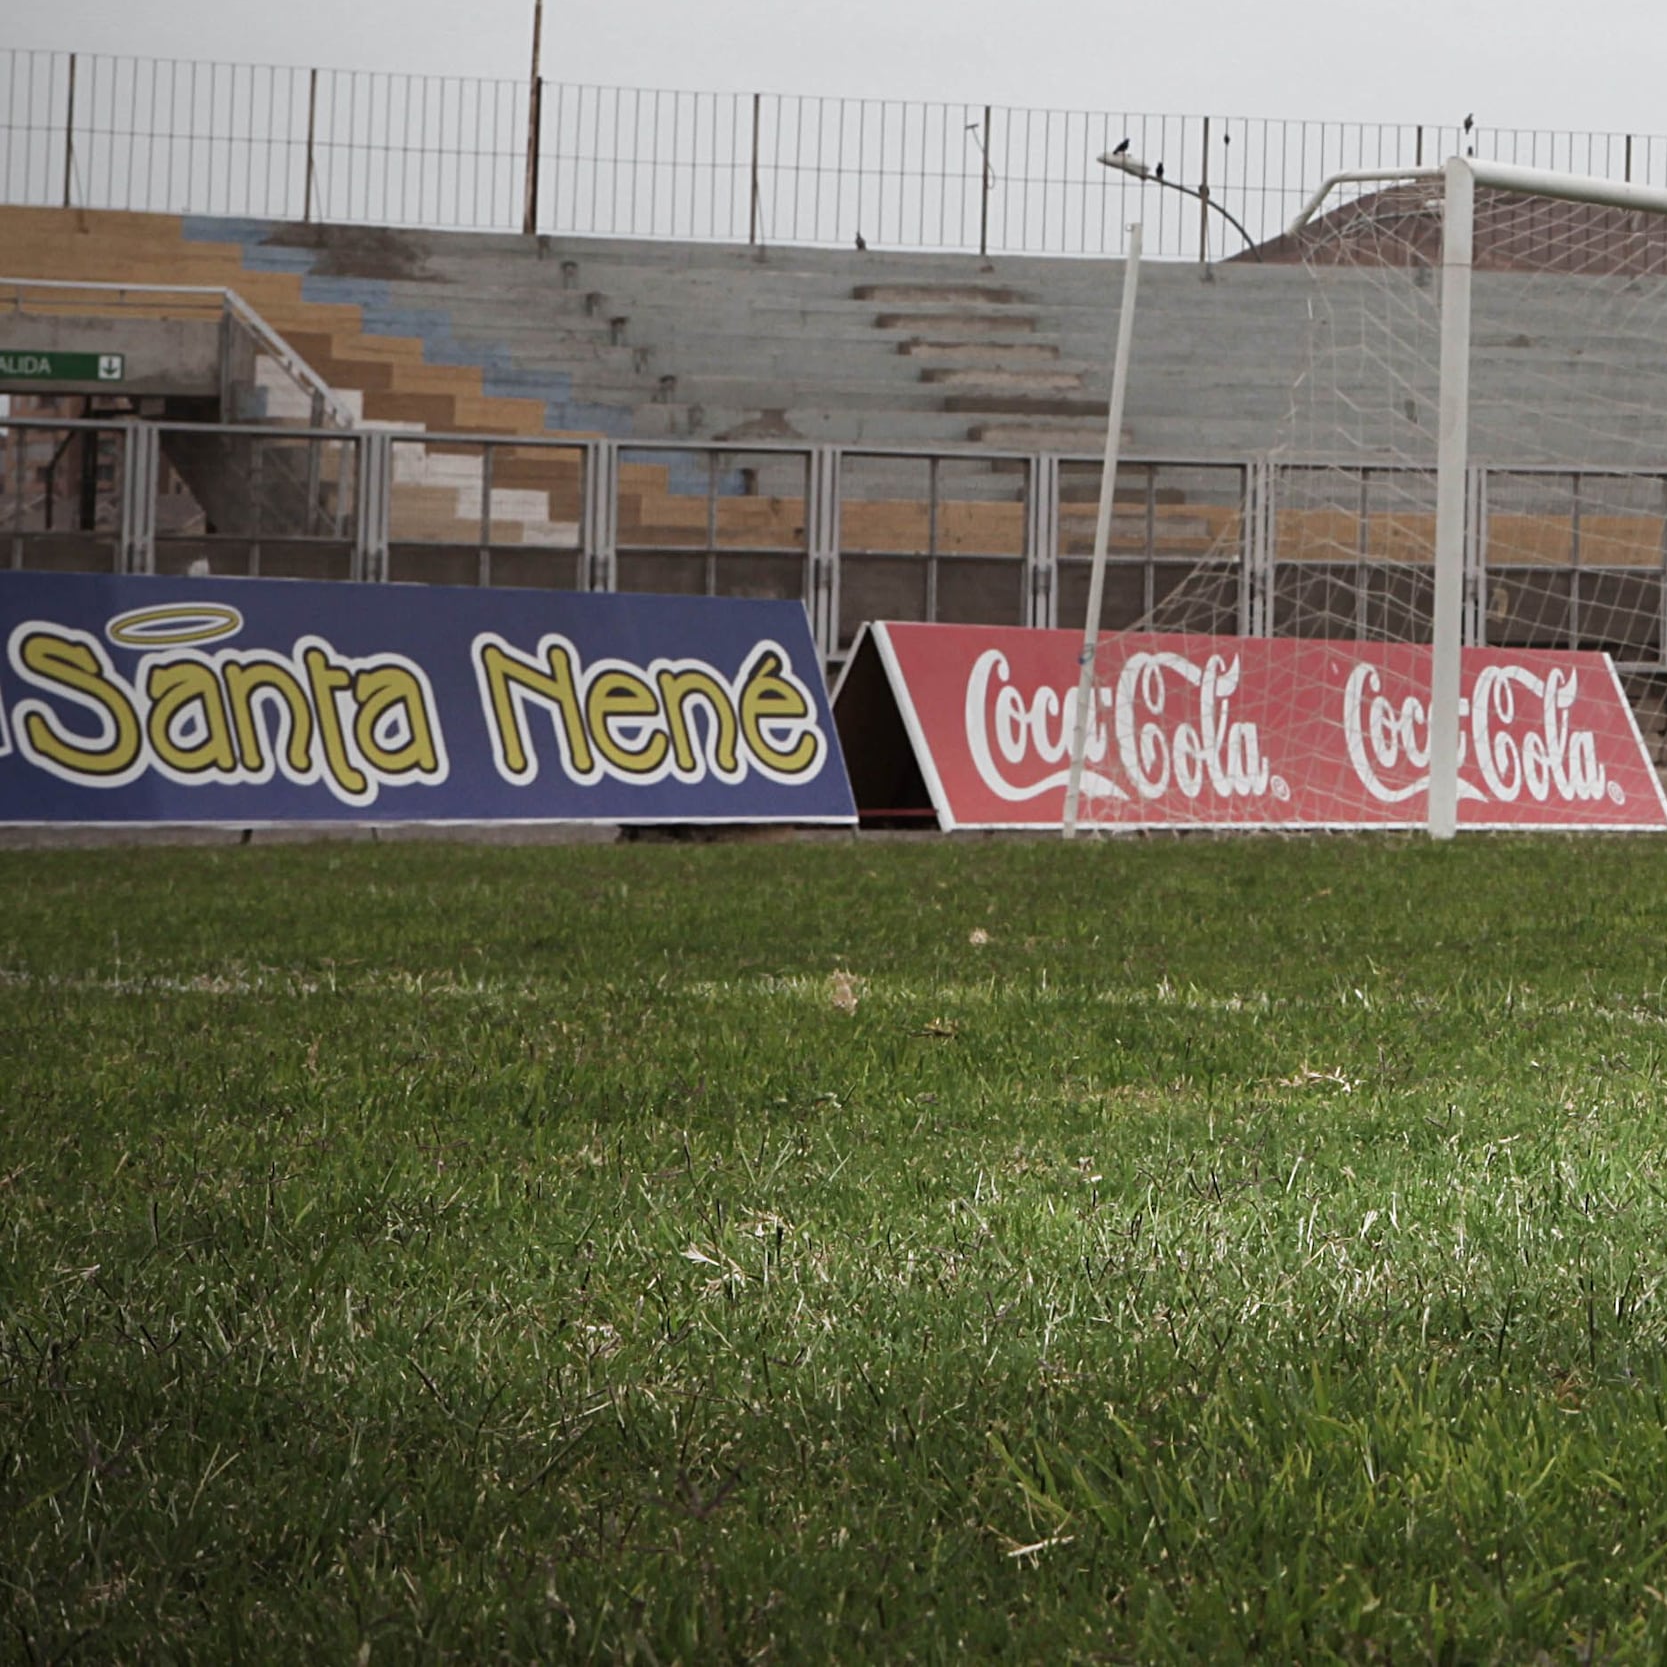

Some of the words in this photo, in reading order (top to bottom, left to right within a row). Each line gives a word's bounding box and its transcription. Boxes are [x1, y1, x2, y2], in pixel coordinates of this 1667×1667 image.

[0, 354, 52, 375] ALIDA
[7, 619, 449, 806] Santa
[471, 632, 828, 786] Nené
[1343, 662, 1606, 803] Coc-Cola
